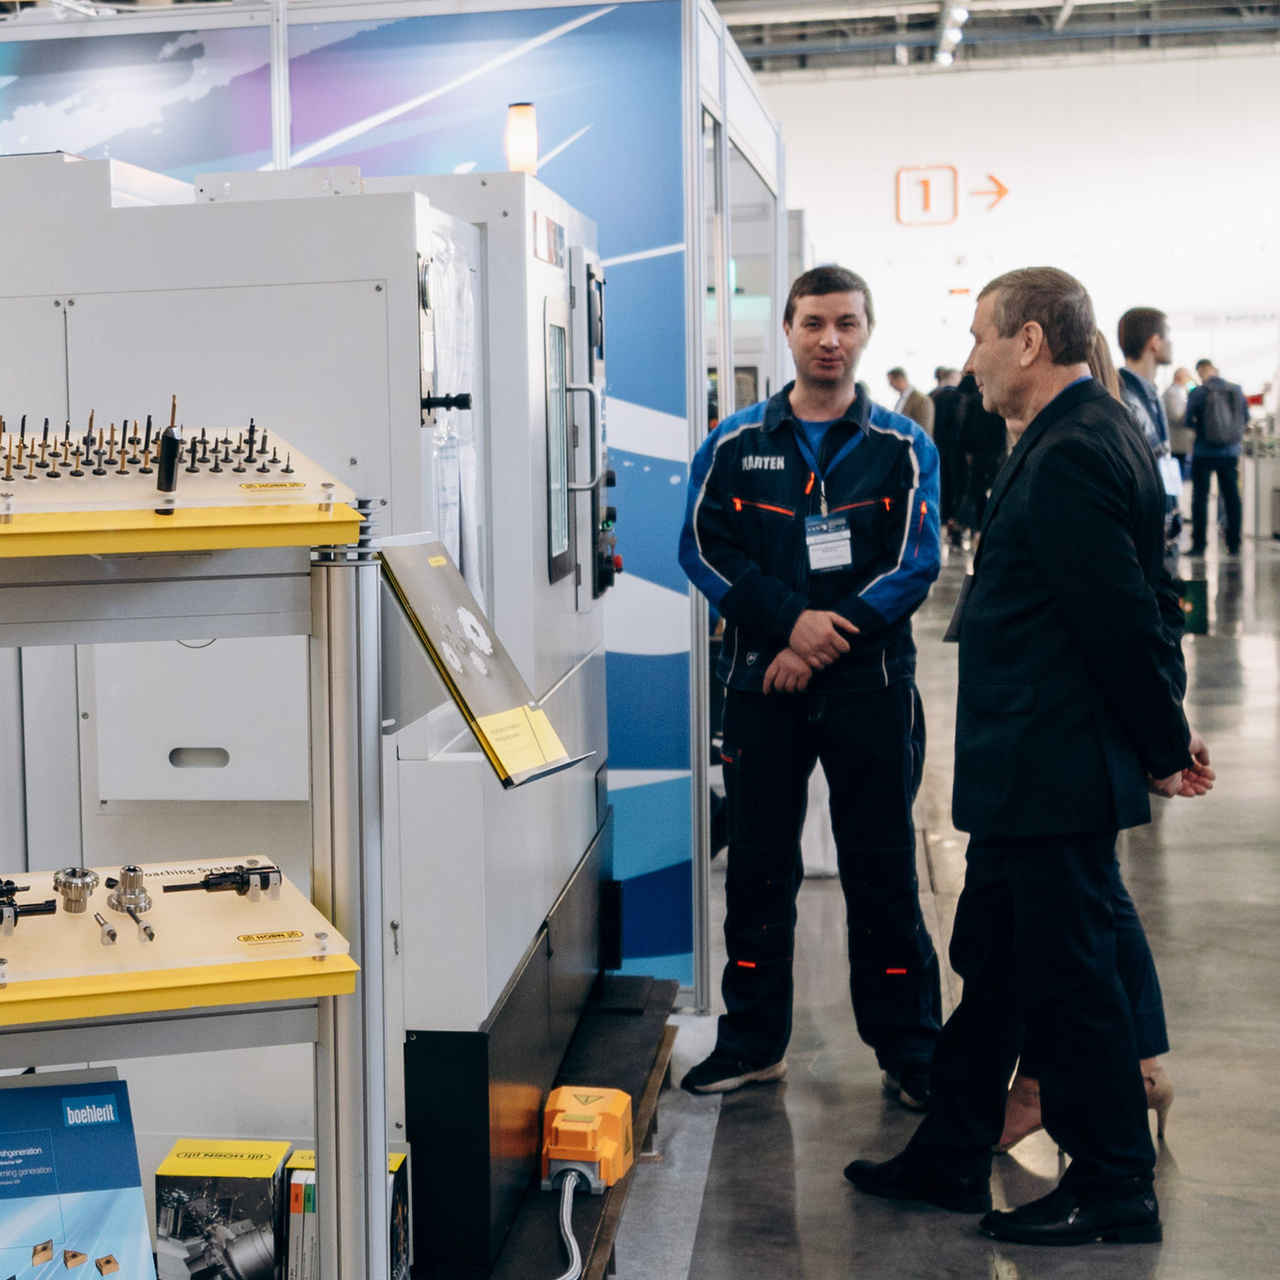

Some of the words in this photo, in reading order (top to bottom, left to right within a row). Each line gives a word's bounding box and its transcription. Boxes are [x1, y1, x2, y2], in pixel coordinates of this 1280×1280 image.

[918, 180, 931, 211] 1
[145, 868, 194, 877] oaching
[197, 865, 238, 874] Syste
[67, 1104, 114, 1124] boehlerit
[18, 1166, 52, 1177] generation
